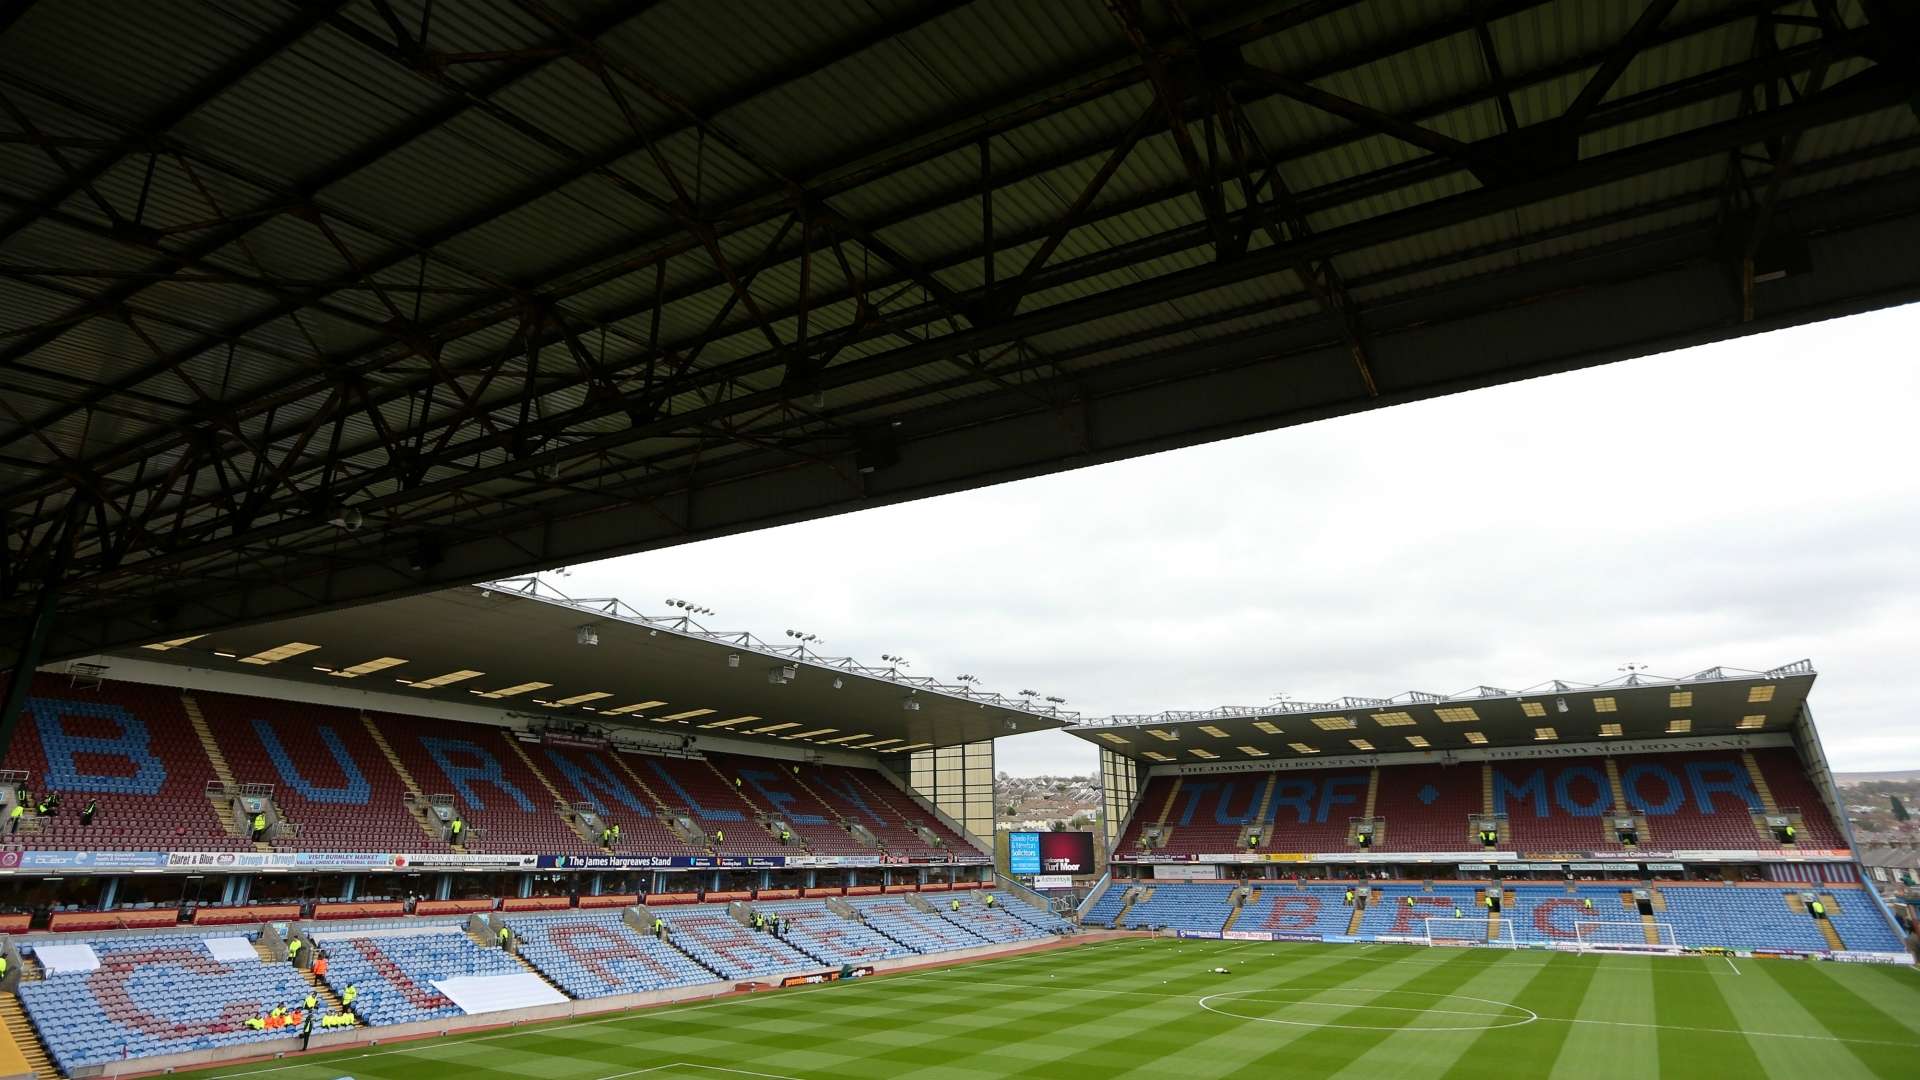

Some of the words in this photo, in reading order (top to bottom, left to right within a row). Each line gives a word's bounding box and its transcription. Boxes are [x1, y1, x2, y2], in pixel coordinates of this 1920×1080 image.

[1490, 749, 1520, 759] THE
[1526, 746, 1588, 757] JIMMY
[1685, 737, 1752, 748] STAND
[1179, 766, 1205, 774] THE
[1208, 764, 1255, 772] JIMMY
[1329, 756, 1380, 766] STAND
[1491, 760, 1766, 818] MOOR
[1179, 775, 1372, 827] TURF
[170, 853, 191, 865] Claret
[199, 854, 214, 865] Blue
[569, 856, 584, 866] The
[585, 857, 608, 867] James
[609, 857, 647, 868] Hargreaves
[648, 857, 671, 866] Stand
[1648, 851, 1673, 859] College
[1045, 863, 1059, 871] Turf
[1060, 863, 1080, 871] Moor
